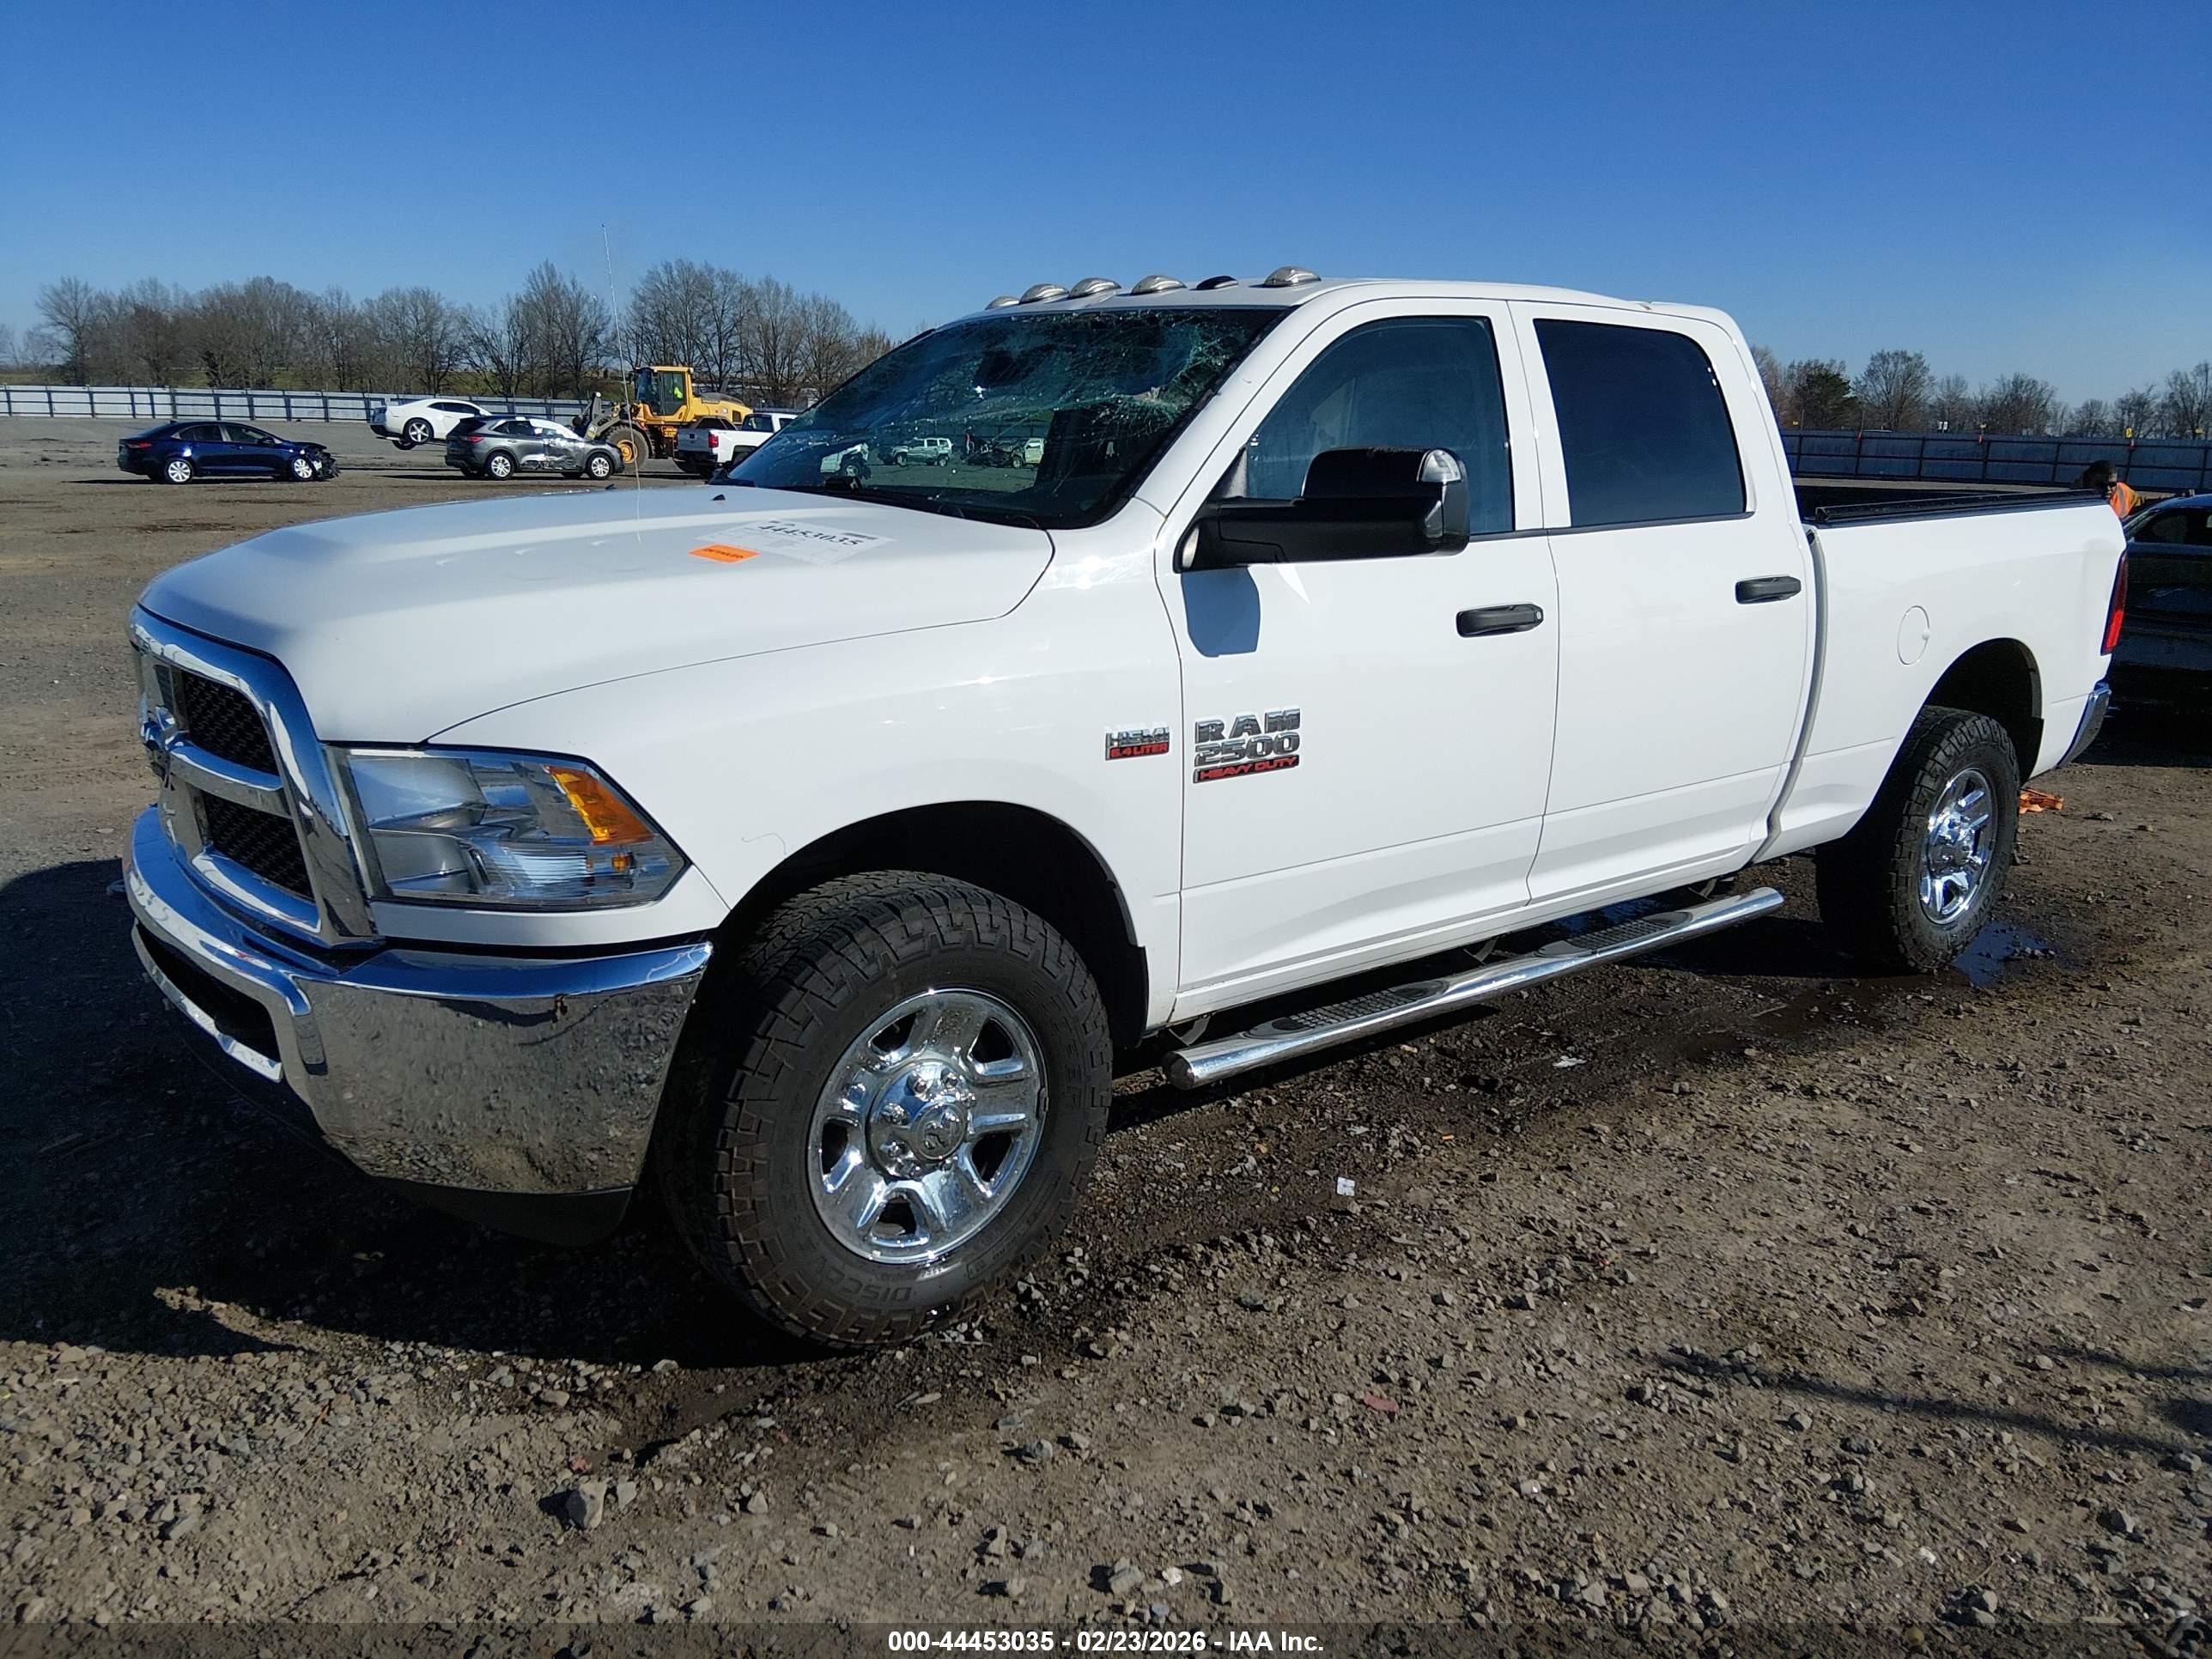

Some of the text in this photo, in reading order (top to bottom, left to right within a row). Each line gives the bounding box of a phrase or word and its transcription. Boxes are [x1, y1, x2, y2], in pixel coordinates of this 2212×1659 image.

[1105, 726, 1170, 747] HEMI
[1194, 708, 1300, 744] RAM
[1194, 732, 1300, 768] 2500
[1200, 756, 1297, 780] HEAVY DUTY
